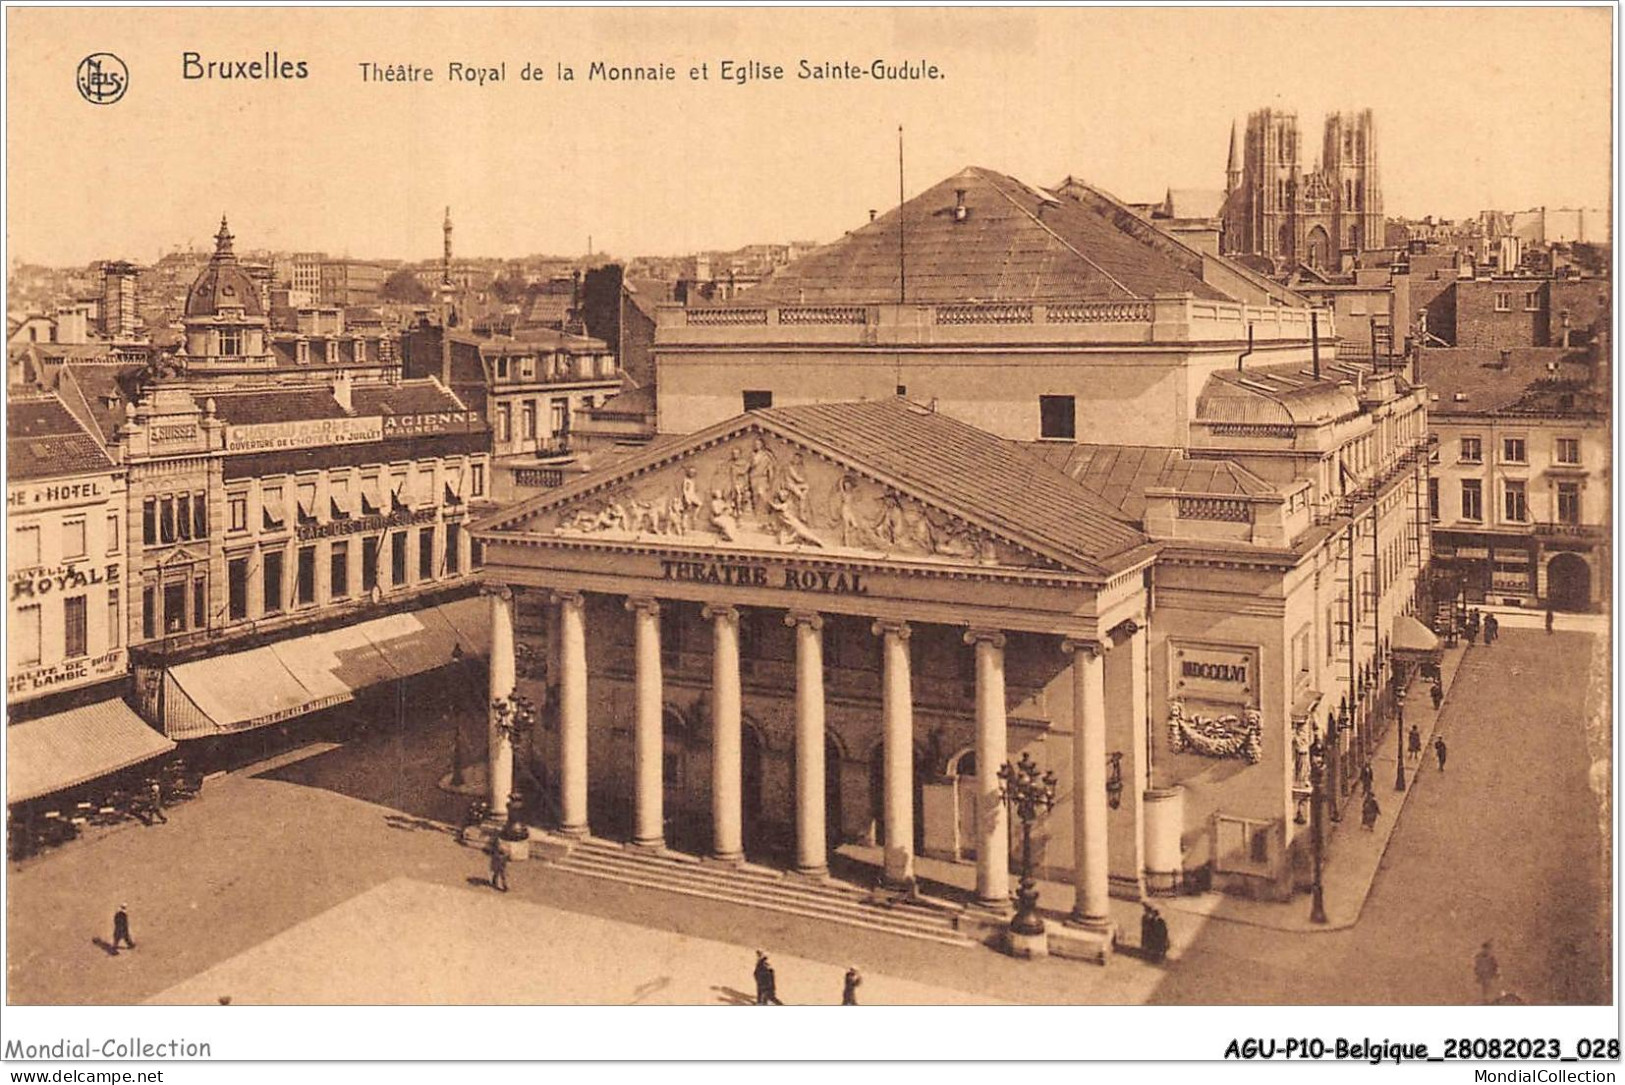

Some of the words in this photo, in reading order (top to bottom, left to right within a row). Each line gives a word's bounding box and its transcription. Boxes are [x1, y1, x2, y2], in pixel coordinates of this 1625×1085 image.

[229, 439, 274, 450] OUVERTURE
[277, 439, 287, 447] DE
[47, 483, 101, 501] HOTEL
[333, 522, 356, 536] DES
[10, 562, 120, 602] ROYALE
[660, 559, 768, 587] THEATRE
[784, 567, 868, 594] ROYAL
[66, 662, 84, 672] DE
[33, 668, 88, 689] LAMBIC
